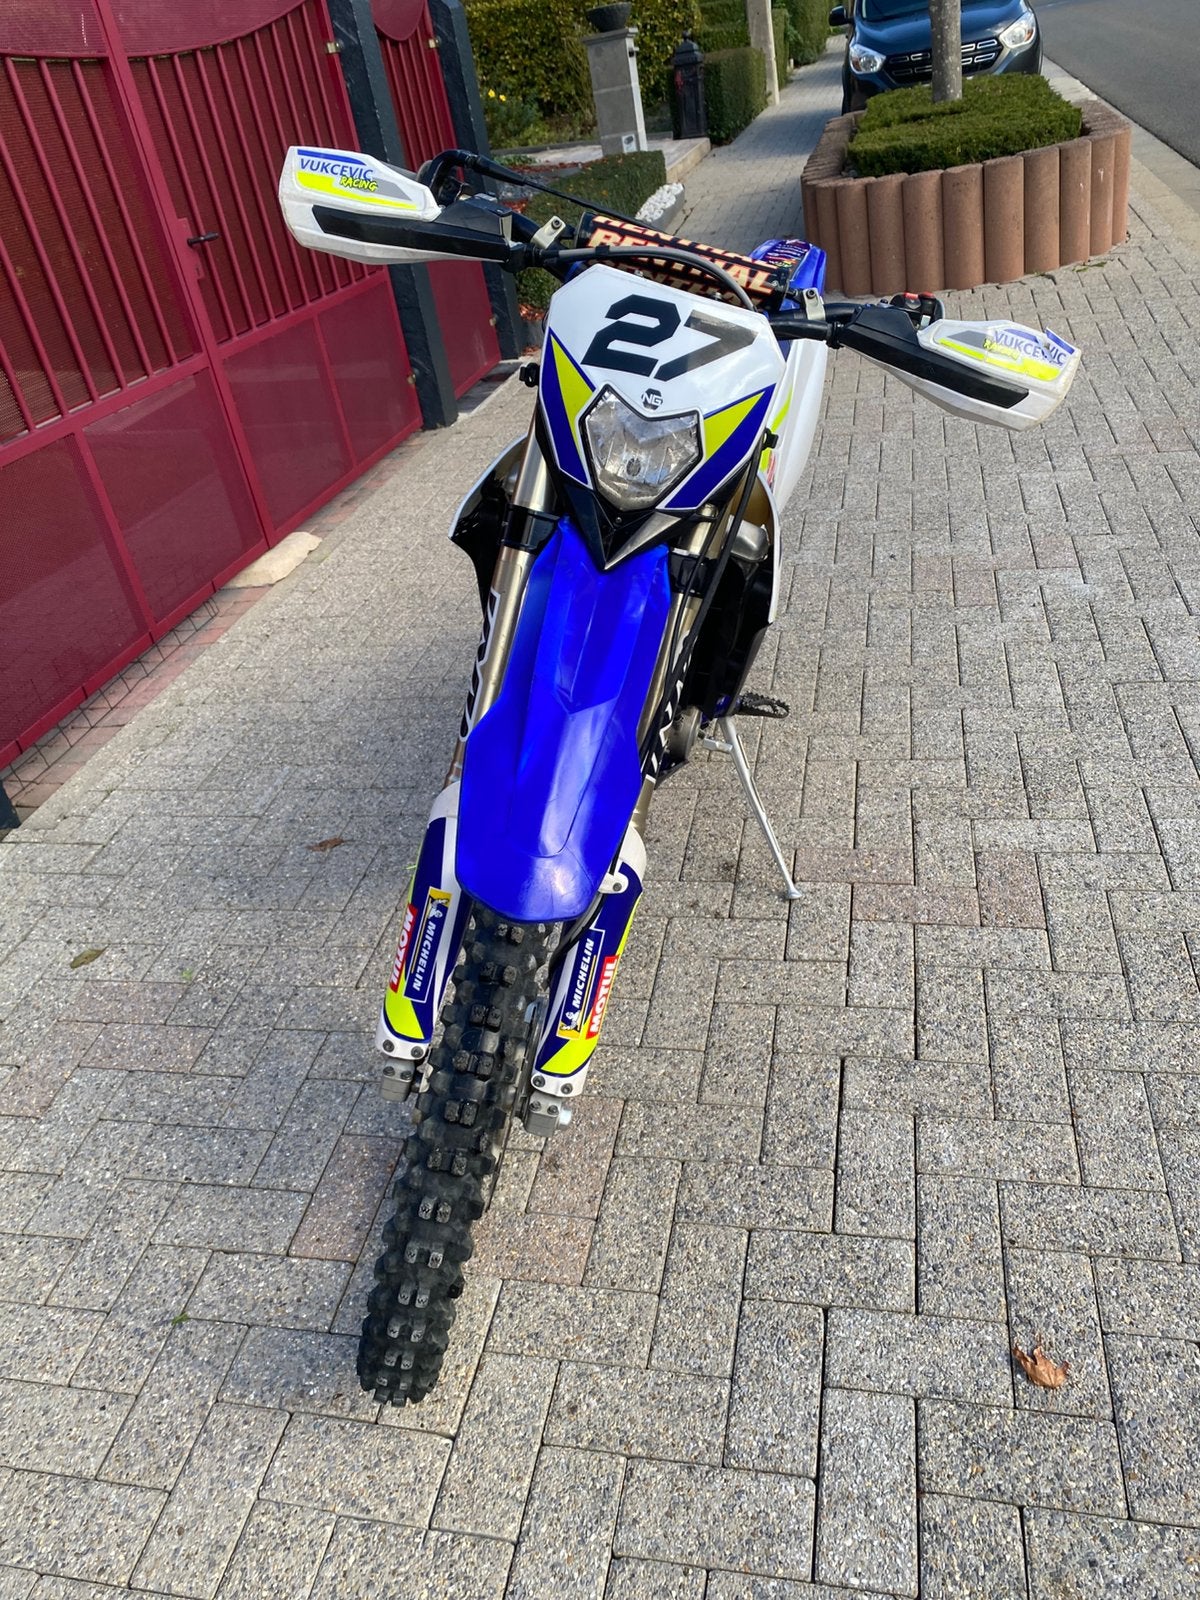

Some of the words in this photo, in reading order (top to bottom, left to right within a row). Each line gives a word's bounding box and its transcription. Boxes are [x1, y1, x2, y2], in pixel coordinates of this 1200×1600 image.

[300, 158, 374, 182] VUKCEVIC
[340, 174, 378, 193] RACING
[580, 293, 760, 383] 27
[641, 391, 664, 406] NG
[412, 920, 437, 992] MICHELIN
[571, 937, 595, 1009] MICHELIN
[589, 958, 618, 1033] MOTUL
